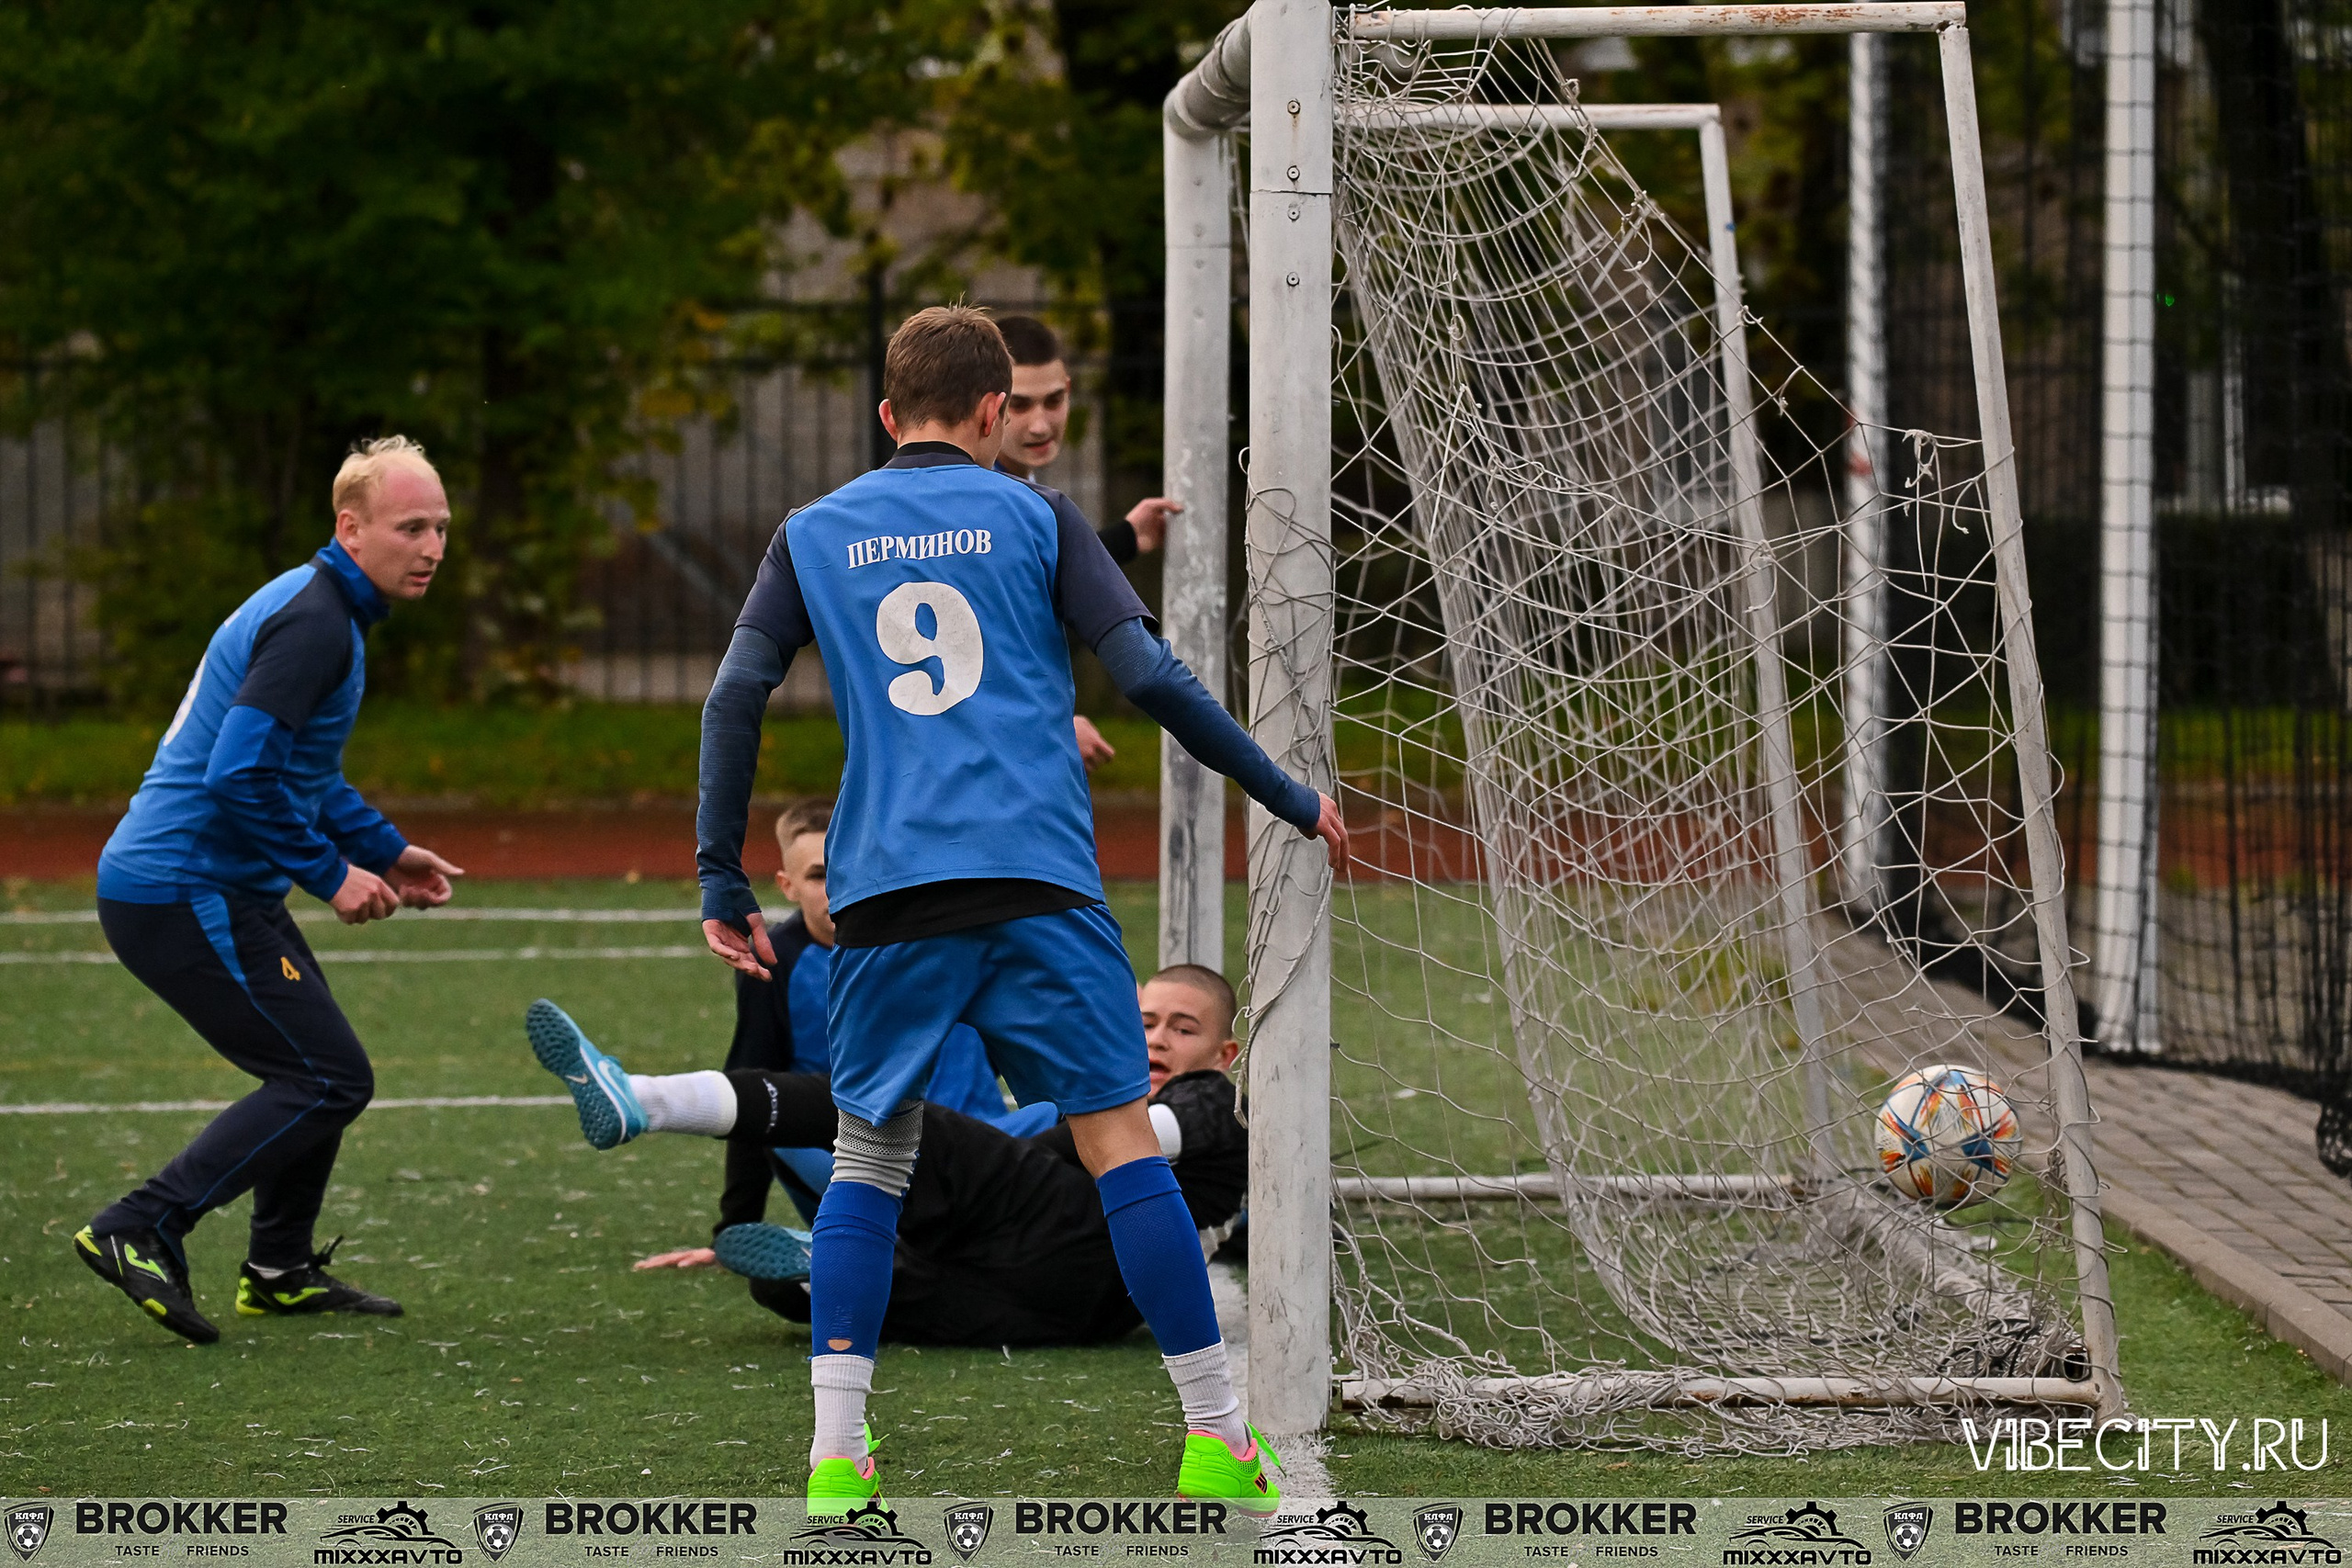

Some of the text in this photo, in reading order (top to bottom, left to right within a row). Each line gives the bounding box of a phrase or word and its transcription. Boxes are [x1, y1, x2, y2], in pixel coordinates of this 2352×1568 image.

[846, 528, 992, 570] ПЕРМИНОВ
[876, 581, 984, 716] 9
[280, 956, 300, 981] 4
